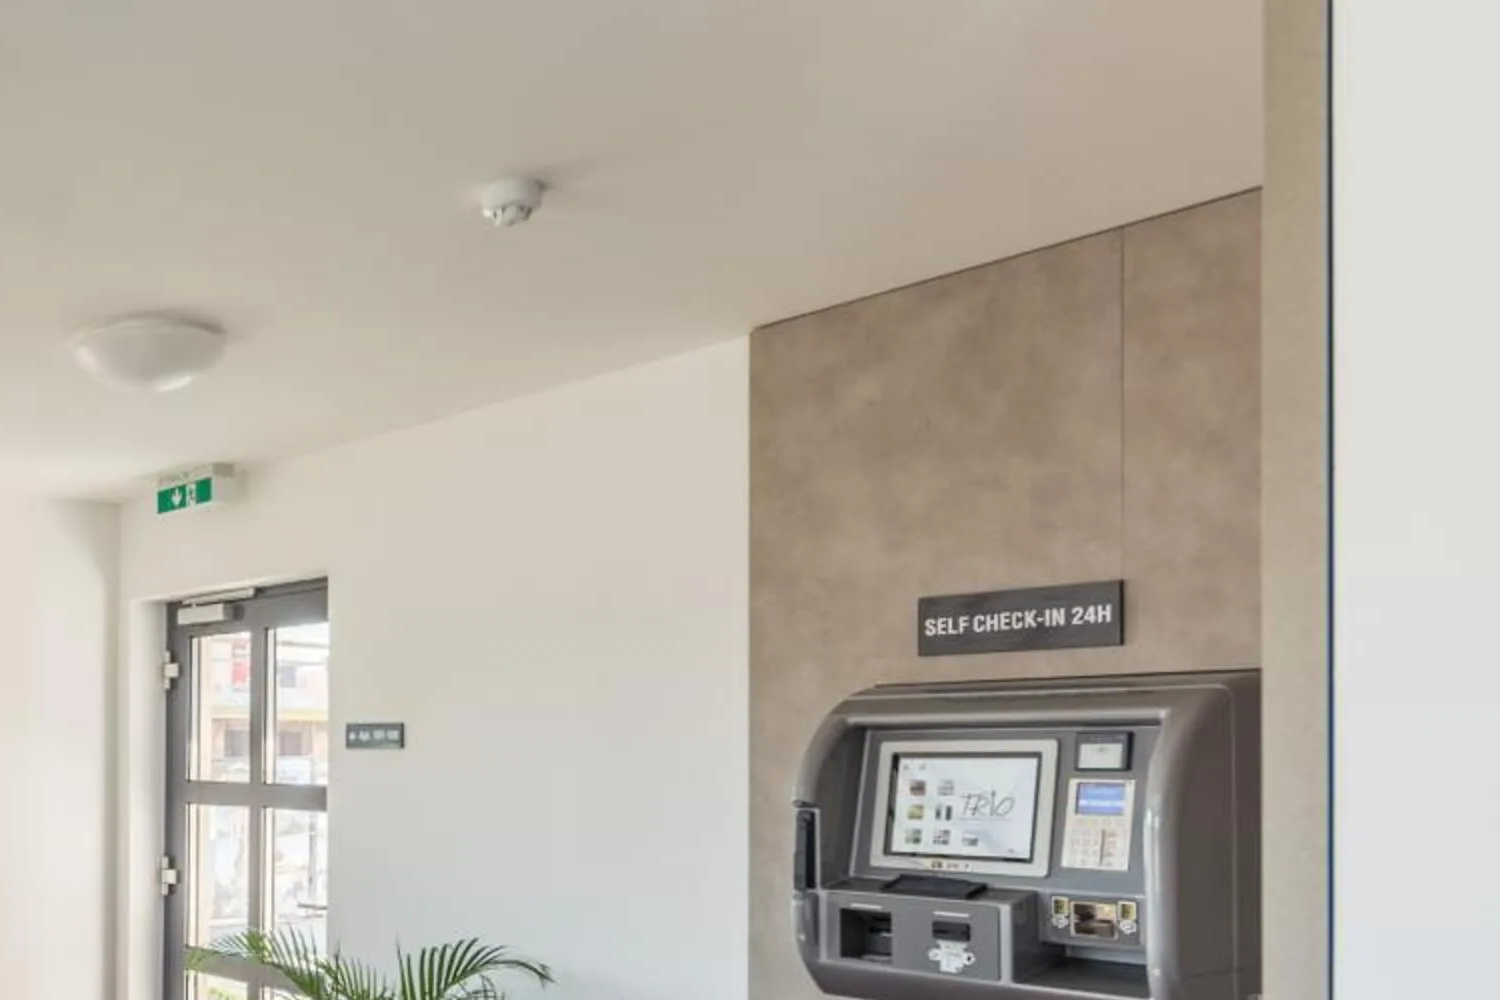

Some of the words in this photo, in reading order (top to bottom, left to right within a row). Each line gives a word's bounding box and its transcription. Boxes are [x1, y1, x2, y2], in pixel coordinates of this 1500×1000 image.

[924, 615, 970, 637] SELF
[972, 607, 1066, 633] CHECK-IN
[1071, 603, 1113, 625] 24H
